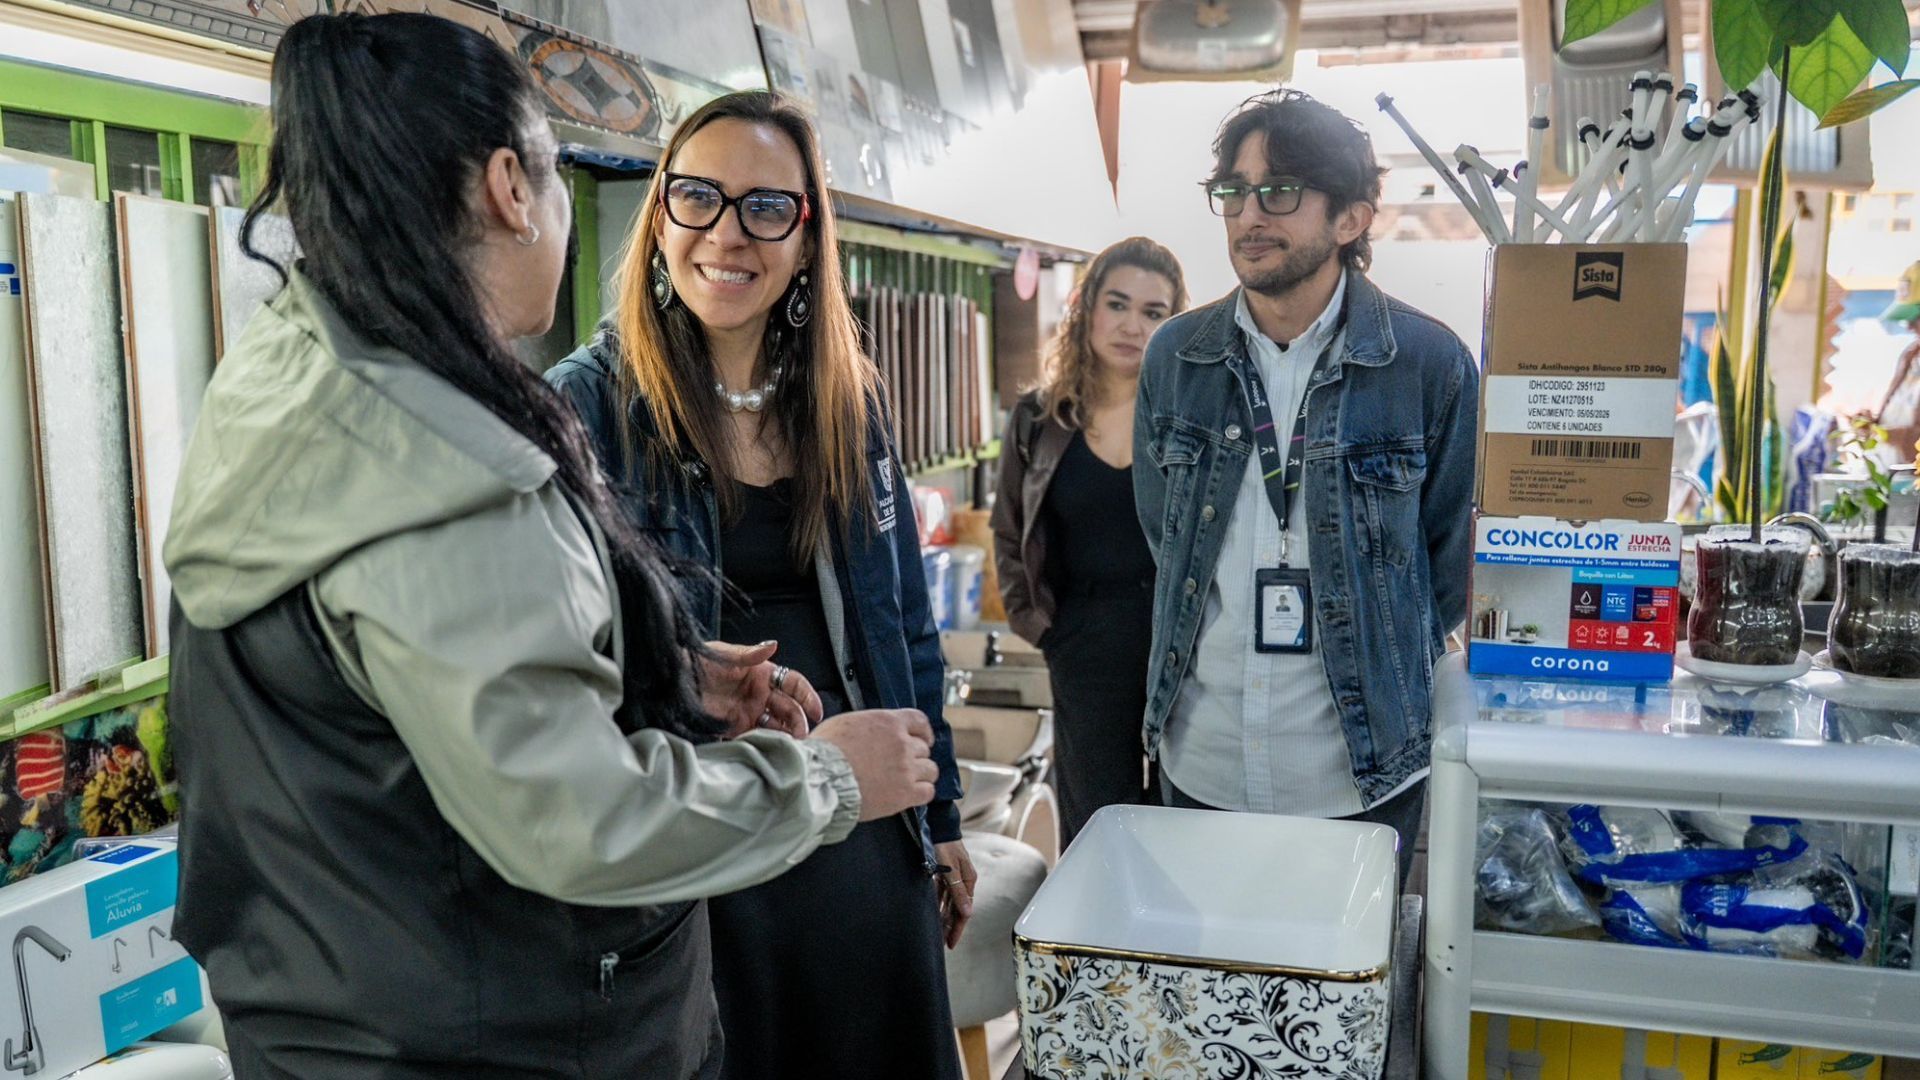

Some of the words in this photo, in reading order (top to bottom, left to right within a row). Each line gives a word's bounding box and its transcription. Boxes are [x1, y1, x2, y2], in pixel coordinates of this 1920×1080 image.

[1582, 268, 1614, 282] Sista
[1518, 363, 1538, 371] Sista
[1593, 365, 1622, 373] Blanco
[1625, 364, 1641, 373] STD
[1644, 365, 1667, 374] 280g
[1576, 381, 1605, 392] 2951123
[1528, 394, 1549, 405] LOTE:
[1551, 395, 1594, 406] NZ41270515
[1528, 408, 1575, 418] VENCIMIENTO:
[1527, 421, 1561, 431] CONTIENE
[1562, 421, 1566, 431] 6
[1568, 422, 1603, 432] UNIDADES
[1486, 528, 1619, 551] CONCOLOR
[1628, 534, 1671, 546] JUNTA
[1627, 545, 1671, 553] ESTRECHA
[1502, 554, 1528, 562] rellenar
[1528, 556, 1551, 564] juntas
[1552, 556, 1583, 564] estrechas
[1585, 557, 1594, 565] de
[1640, 559, 1670, 568] baldosas
[1606, 597, 1626, 605] NTC
[1531, 656, 1609, 671] corona
[106, 901, 142, 925] Aluvia
